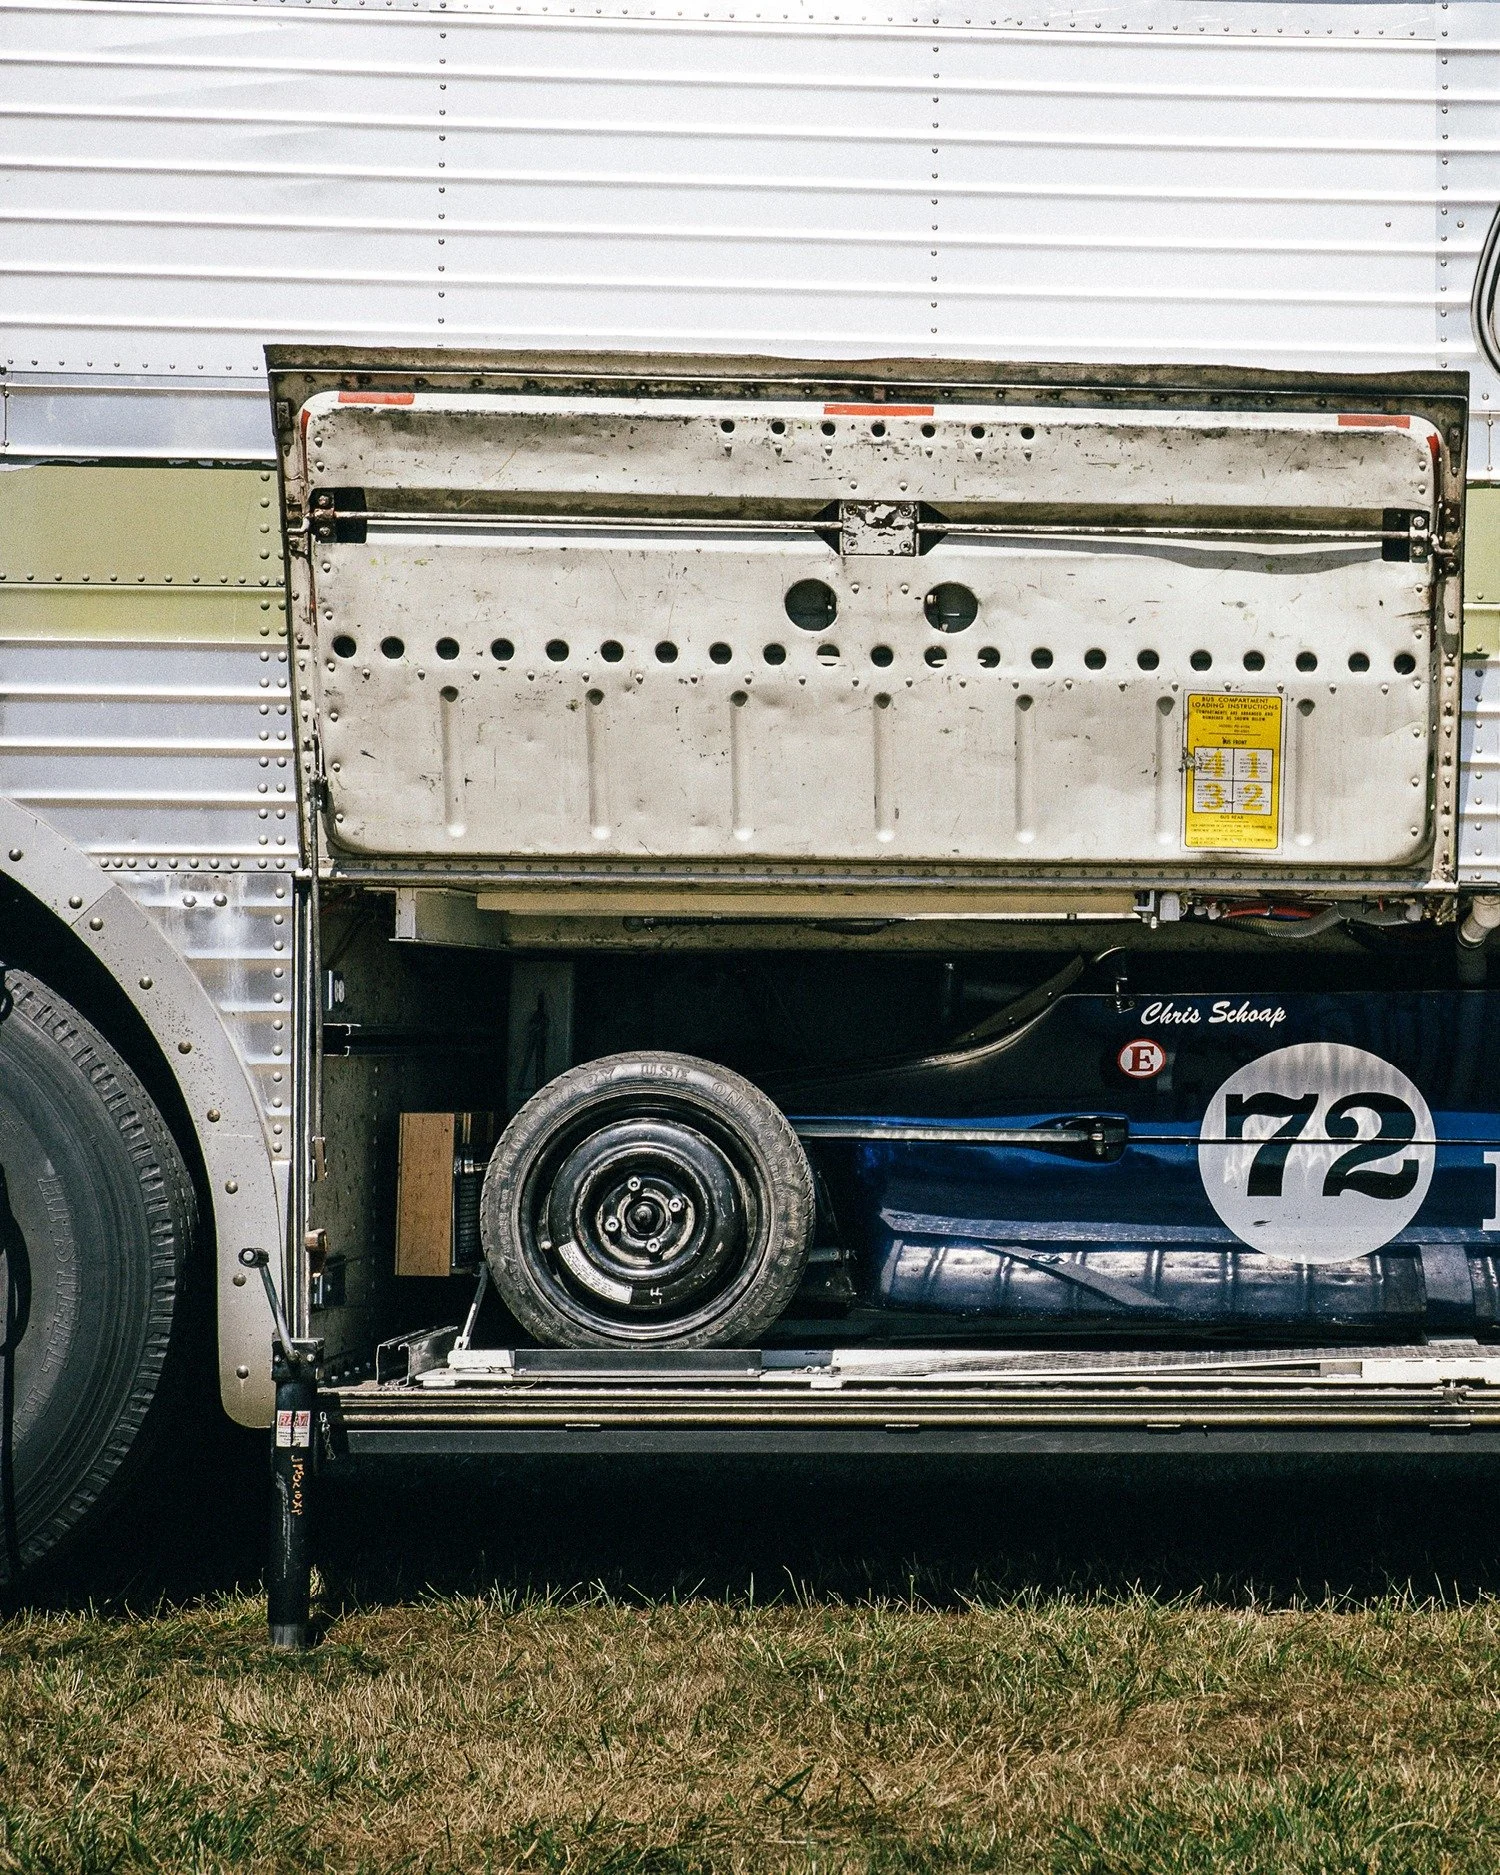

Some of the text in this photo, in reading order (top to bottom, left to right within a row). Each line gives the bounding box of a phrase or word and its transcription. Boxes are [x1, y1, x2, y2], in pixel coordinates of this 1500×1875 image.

[1203, 750, 1225, 777] 4
[1247, 752, 1260, 779] 1
[1203, 783, 1224, 810] 3
[1243, 783, 1264, 810] 2
[1140, 1001, 1286, 1028] Chris Schoap
[1128, 1046, 1154, 1072] E
[497, 1064, 768, 1179] TEMPORARY USE ONLY
[1225, 1091, 1420, 1200] 72
